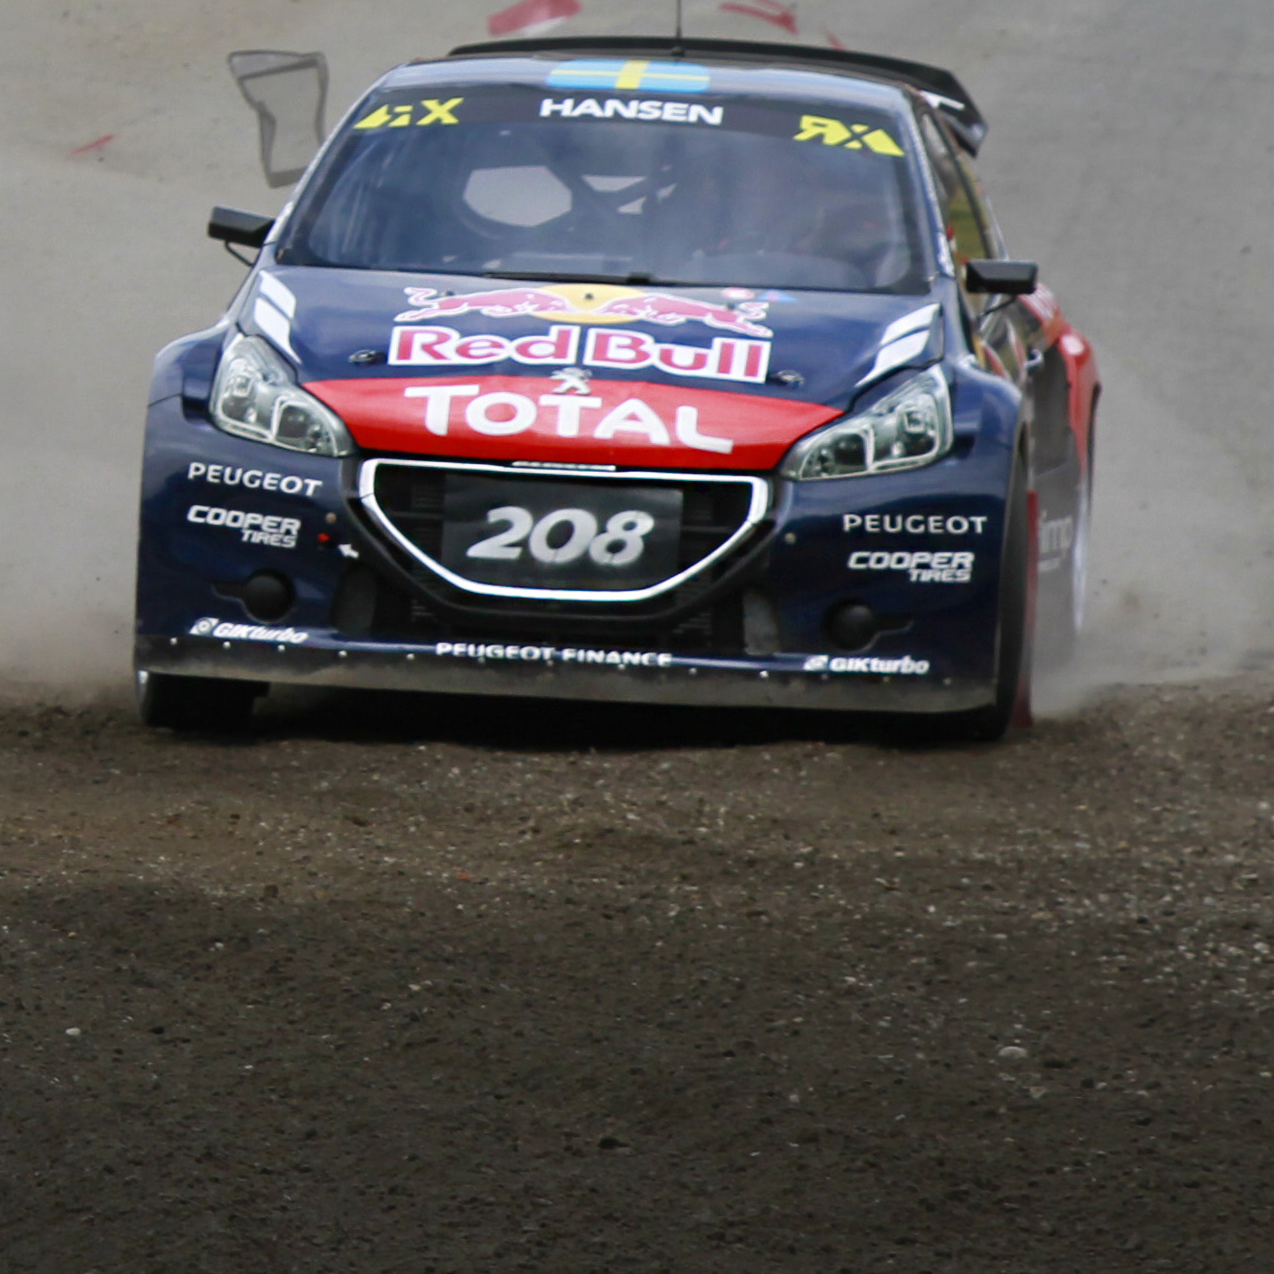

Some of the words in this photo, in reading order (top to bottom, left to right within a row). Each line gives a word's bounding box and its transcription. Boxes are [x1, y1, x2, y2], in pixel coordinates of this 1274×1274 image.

[539, 98, 724, 125] HANSEN
[389, 326, 581, 365] Red
[584, 328, 771, 383] Bull
[404, 383, 734, 454] TOTAL
[187, 461, 323, 497] PEUGEOT
[187, 504, 302, 536] COOPER
[842, 513, 988, 535] PEUGEOT
[241, 528, 298, 549] TIRES
[466, 505, 655, 566] 208
[847, 551, 975, 570] COOPER
[908, 568, 973, 583] TIRES
[435, 642, 556, 661] PEUGEOT
[562, 647, 673, 667] FINANCE
